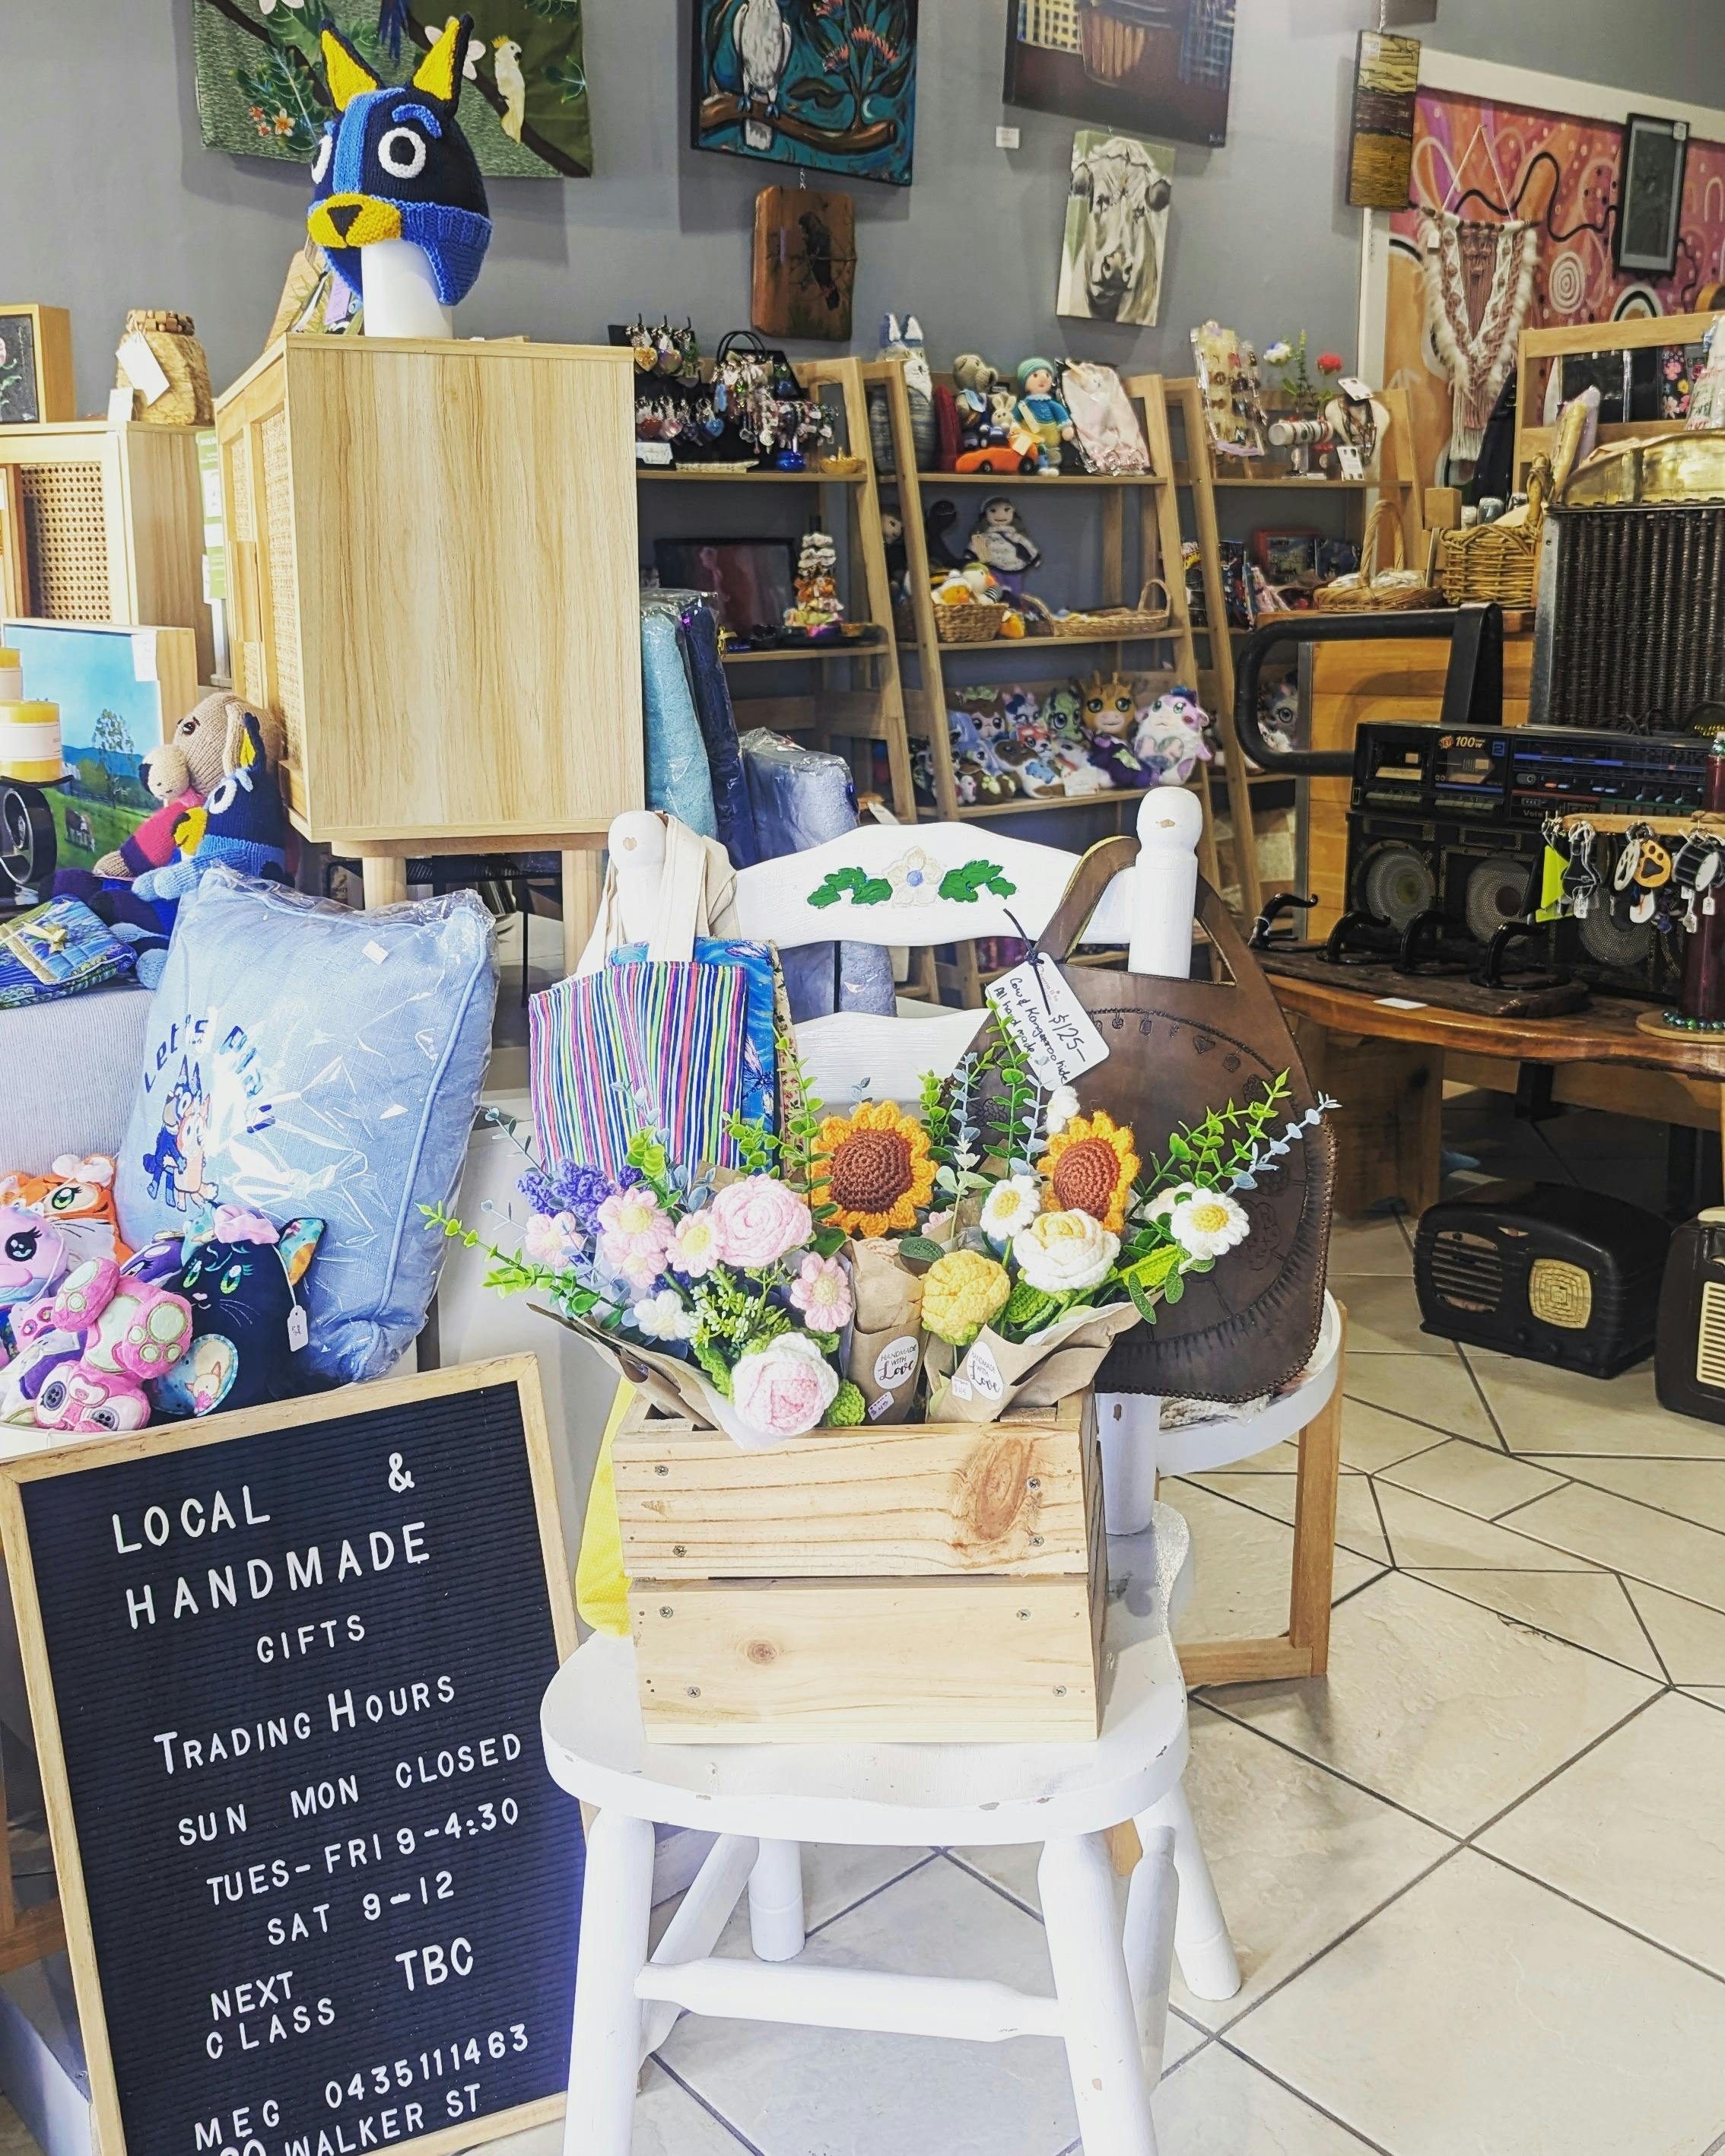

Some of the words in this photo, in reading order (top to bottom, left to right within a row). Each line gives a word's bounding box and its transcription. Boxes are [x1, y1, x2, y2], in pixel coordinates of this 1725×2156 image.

[993, 986, 1007, 1000] All
[1010, 977, 1023, 998] Cow
[1056, 1060, 1072, 1084] hide
[878, 1360, 914, 1381] Love
[880, 1344, 917, 1361] HANDMADE
[891, 1355, 907, 1365] WITH
[969, 1360, 1001, 1393] Love
[113, 1485, 270, 1554] LOCAL
[389, 1453, 415, 1493] &
[126, 1522, 429, 1629] HANDMADE
[257, 1615, 365, 1663] GIFTS
[154, 1713, 311, 1774] TRADING
[328, 1676, 454, 1732] HOURS
[179, 1804, 247, 1846] SUN
[291, 1775, 359, 1818] MON
[396, 1734, 521, 1789] CLOSED
[268, 1904, 330, 1945] SAT
[363, 1871, 454, 1921] 9-12
[211, 1971, 294, 2021] NEXT
[396, 1938, 474, 1992] TBC
[207, 1999, 335, 2059] CLASS
[195, 2100, 280, 2151] MEG
[326, 2024, 529, 2109] 0435111463
[284, 2102, 424, 2156] WALKER
[446, 2083, 481, 2117] ST
